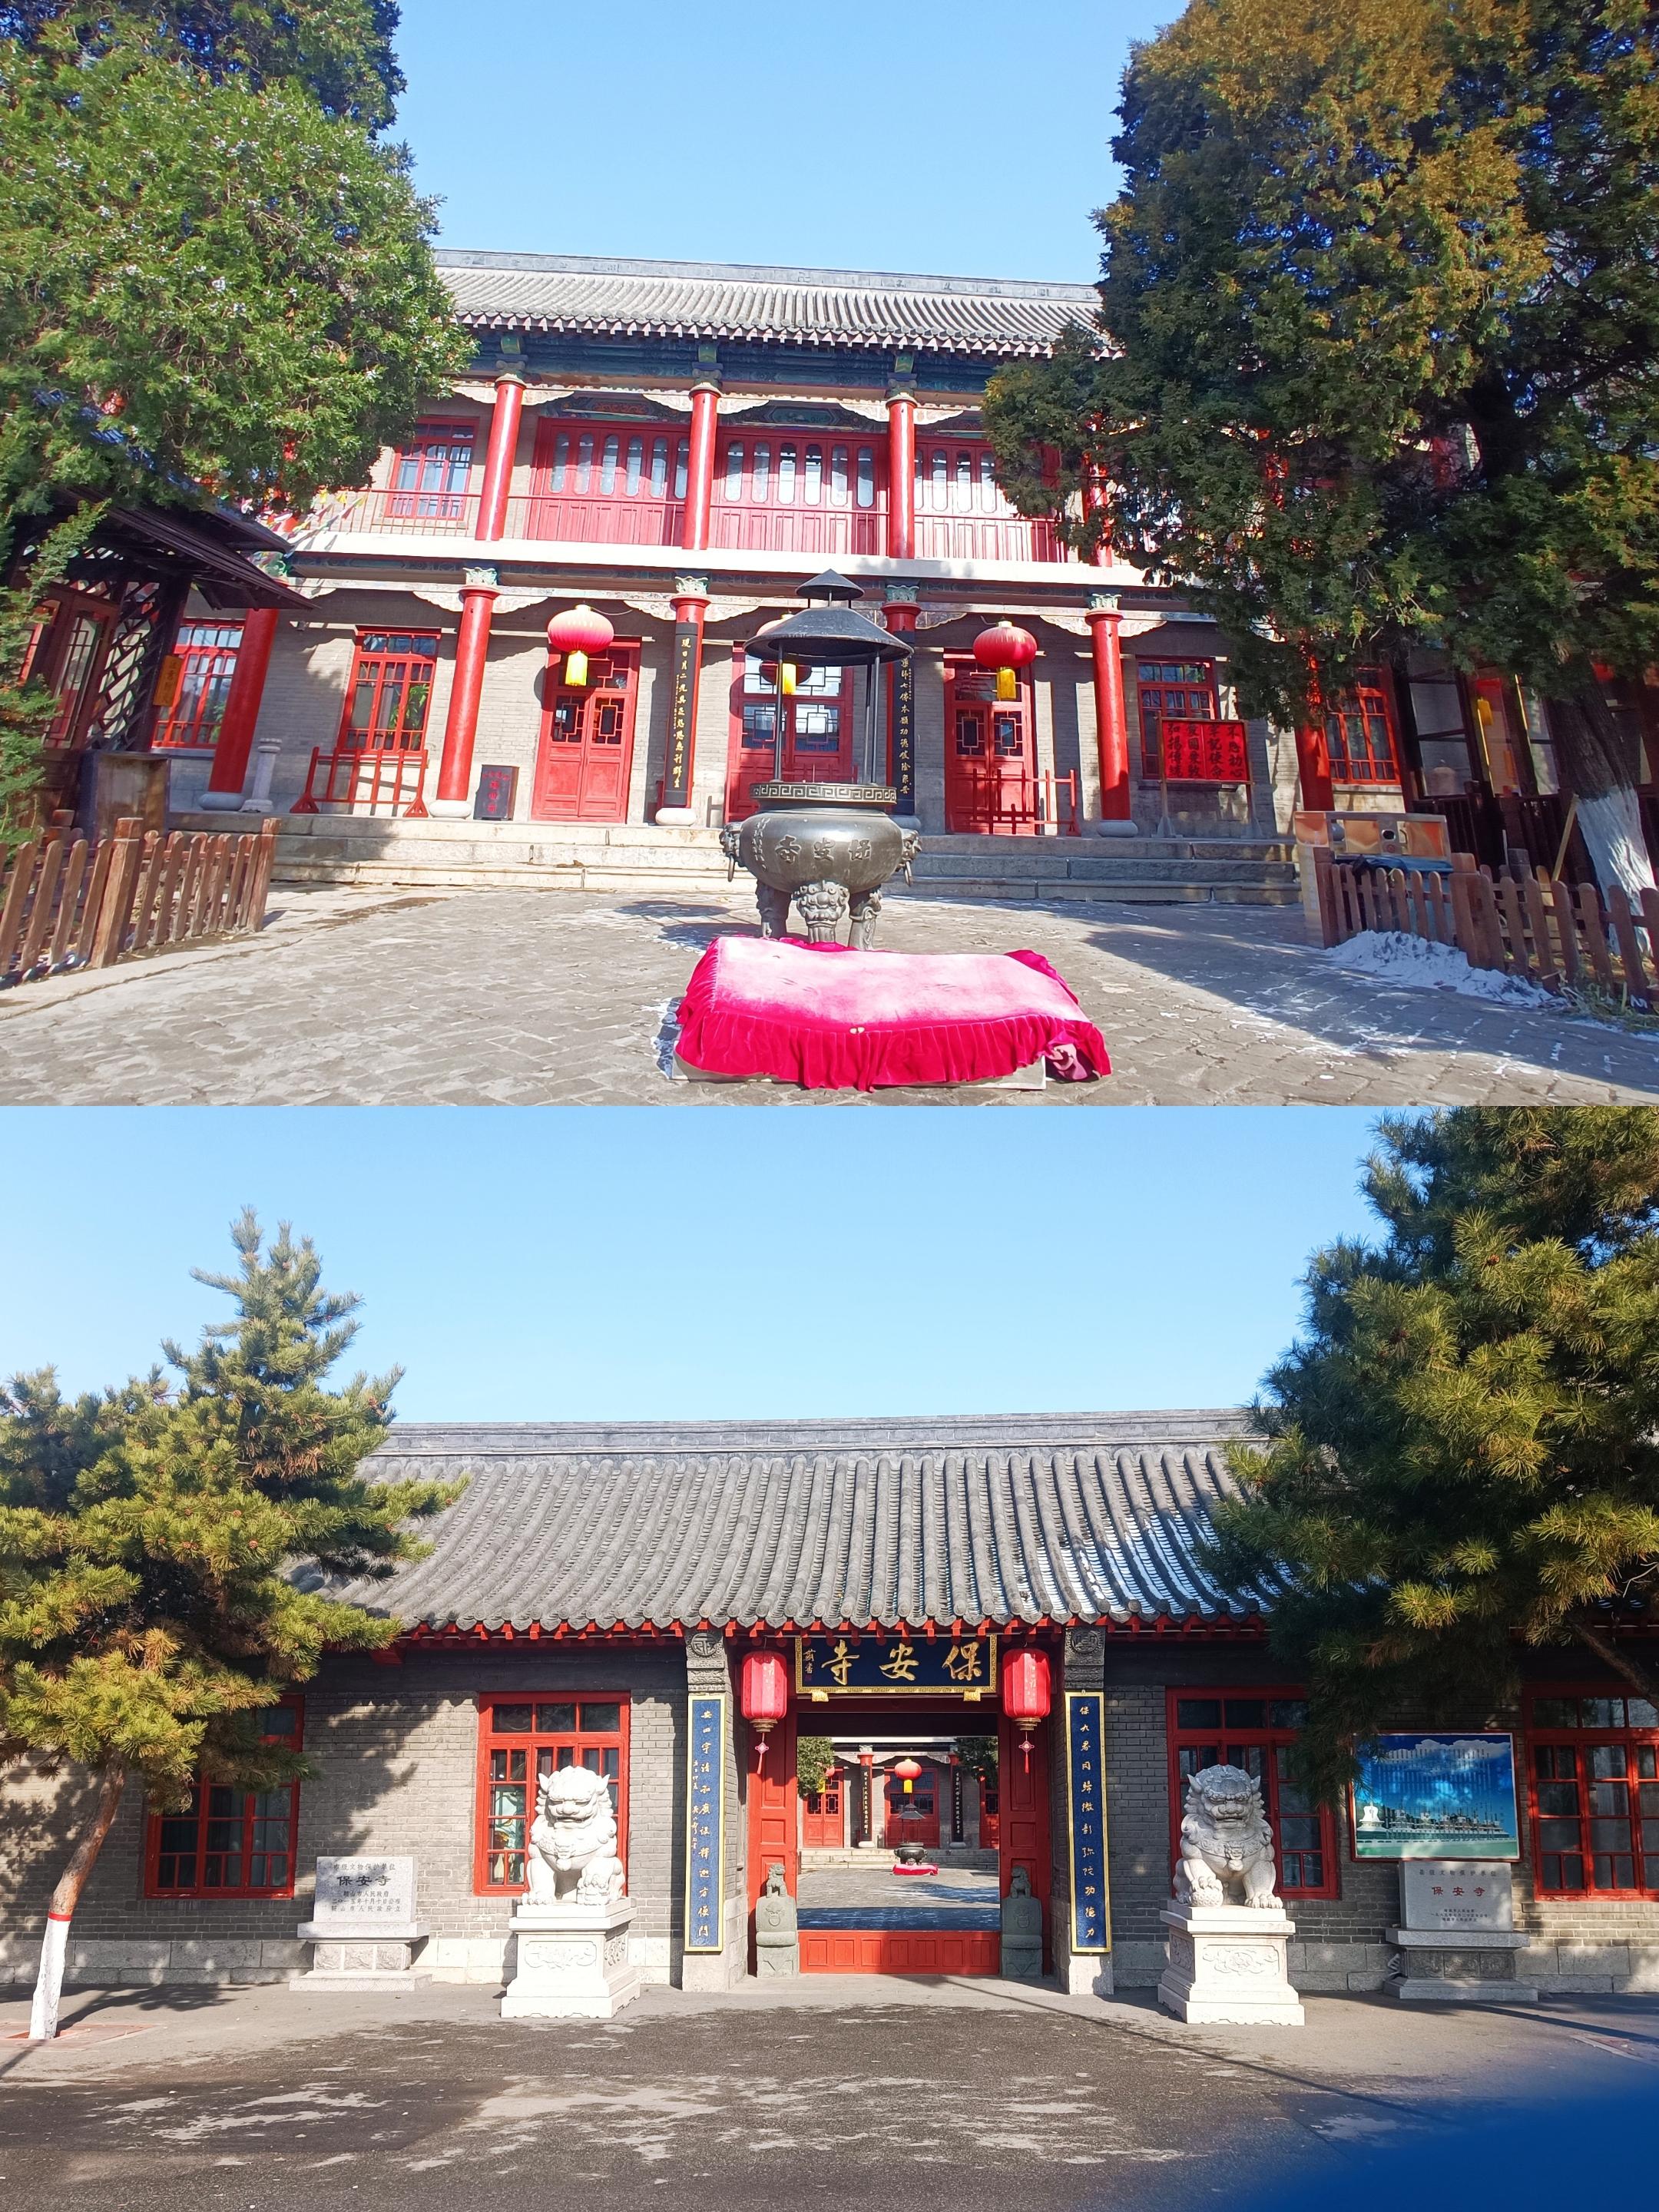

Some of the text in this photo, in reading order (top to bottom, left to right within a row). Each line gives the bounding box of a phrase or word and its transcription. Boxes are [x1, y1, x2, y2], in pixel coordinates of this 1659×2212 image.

[775, 835, 873, 864] 保安寺
[821, 1639, 982, 1686] 保安寺
[336, 1875, 392, 1886] 保安寺
[1432, 1886, 1485, 1897] 保安寺
